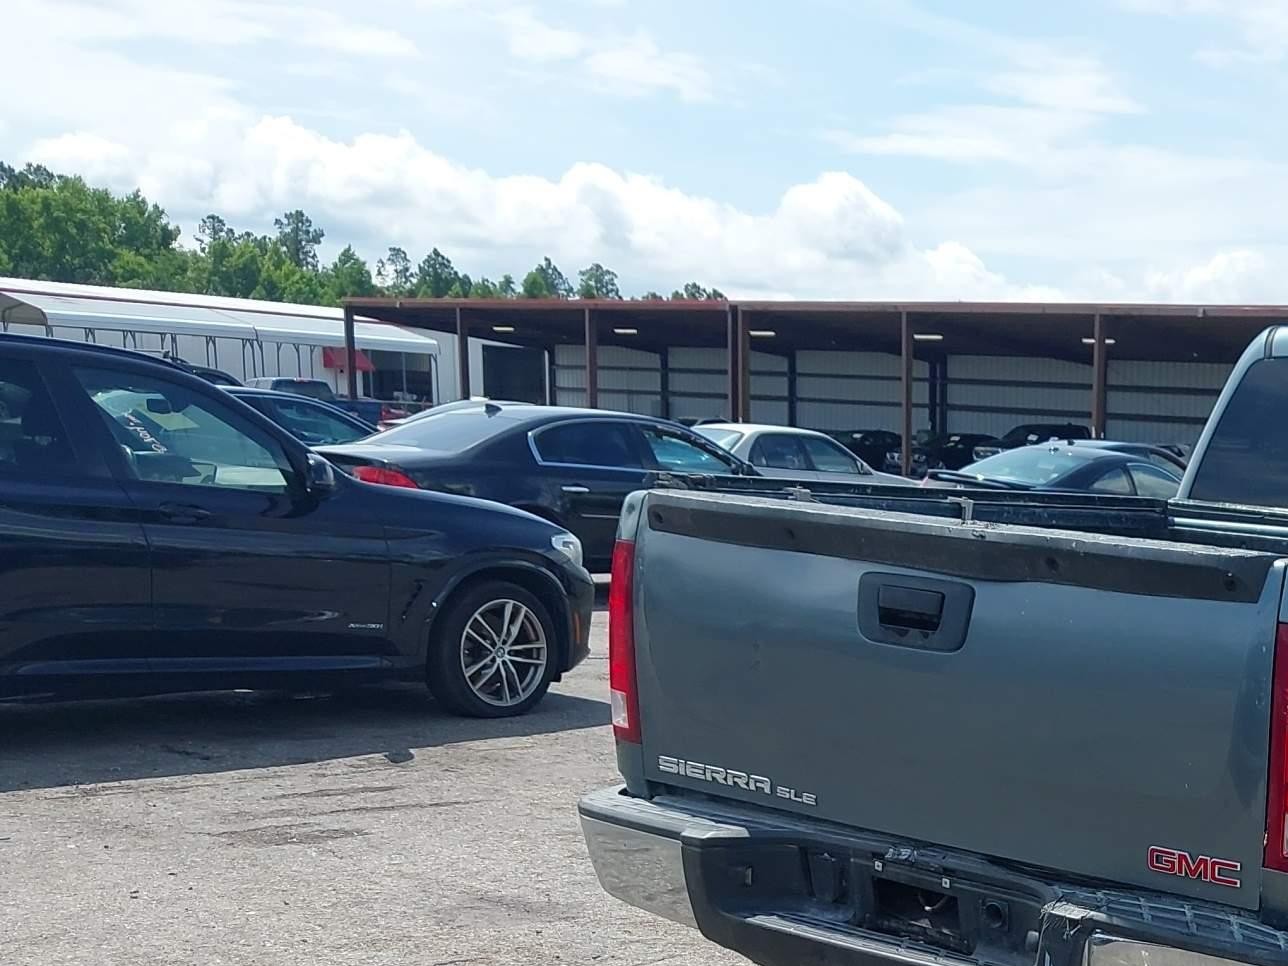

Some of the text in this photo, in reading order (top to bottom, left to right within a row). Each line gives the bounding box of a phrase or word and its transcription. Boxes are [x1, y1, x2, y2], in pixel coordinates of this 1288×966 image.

[656, 755, 818, 806] SIERRA SLE
[1147, 845, 1241, 888] GMC
